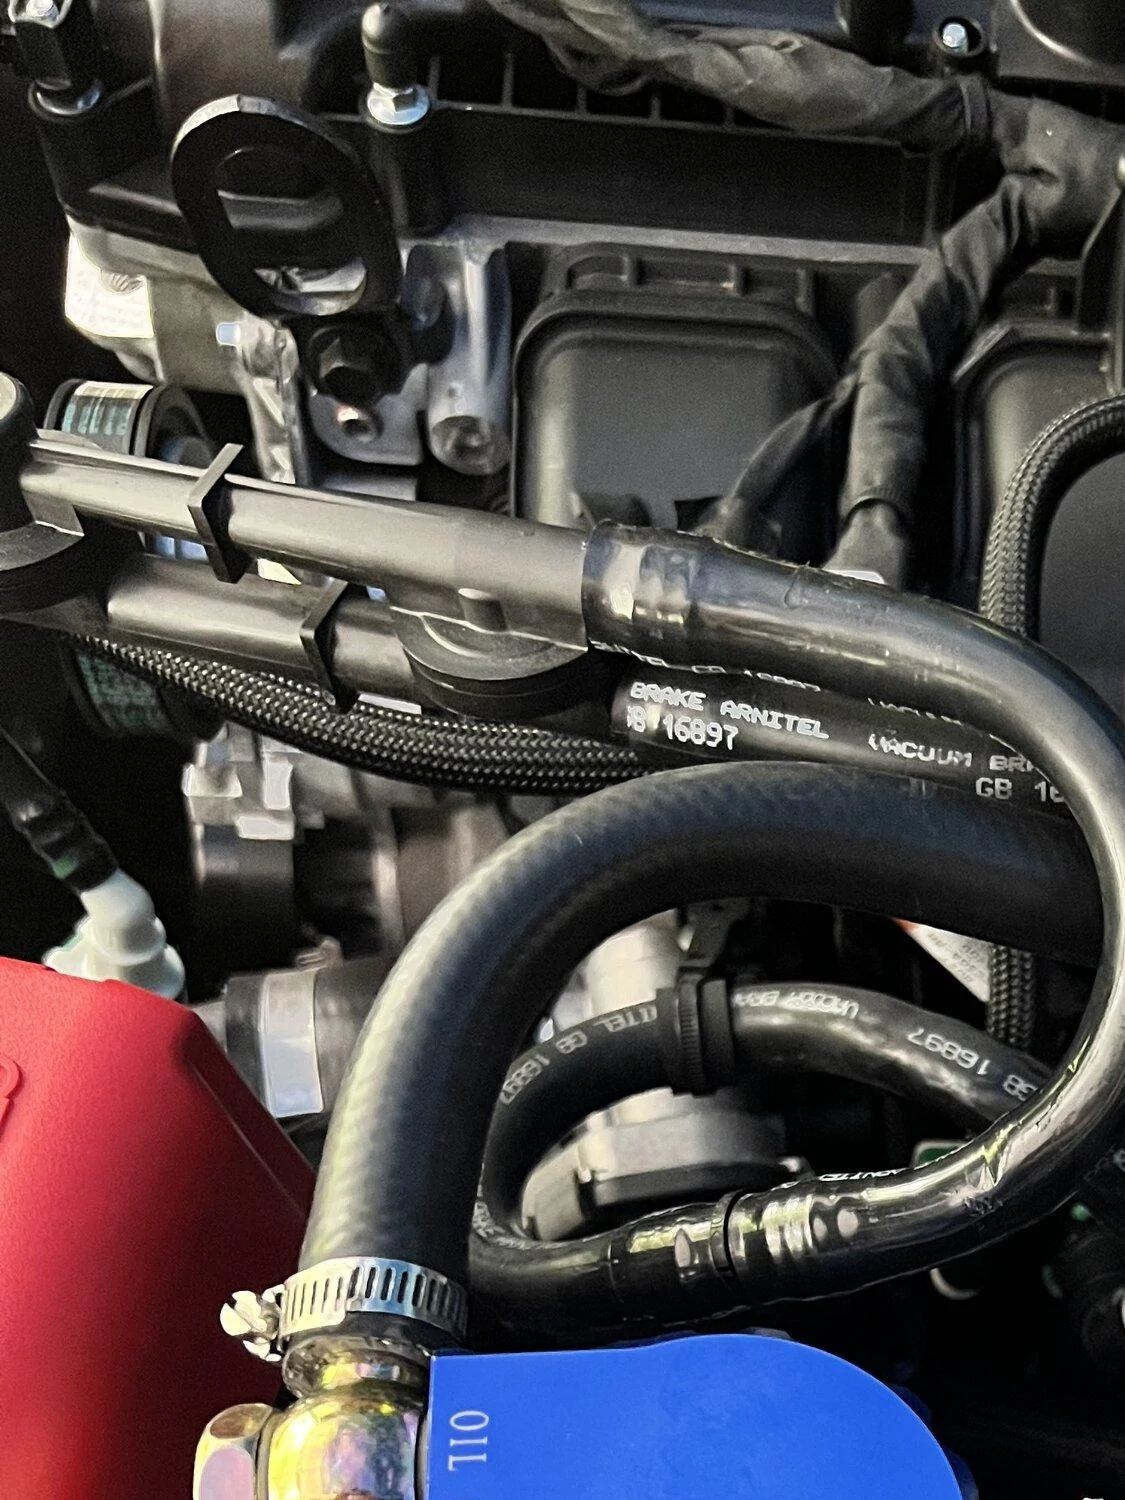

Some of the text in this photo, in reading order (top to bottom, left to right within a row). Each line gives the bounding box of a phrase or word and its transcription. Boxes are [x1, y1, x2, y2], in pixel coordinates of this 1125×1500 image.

[630, 681, 707, 711] BRAKE
[720, 700, 830, 740] ARNITEL
[663, 713, 739, 751] 16897
[975, 777, 1012, 800] GB
[906, 1028, 991, 1076] 16897
[448, 1409, 490, 1472] OIL
